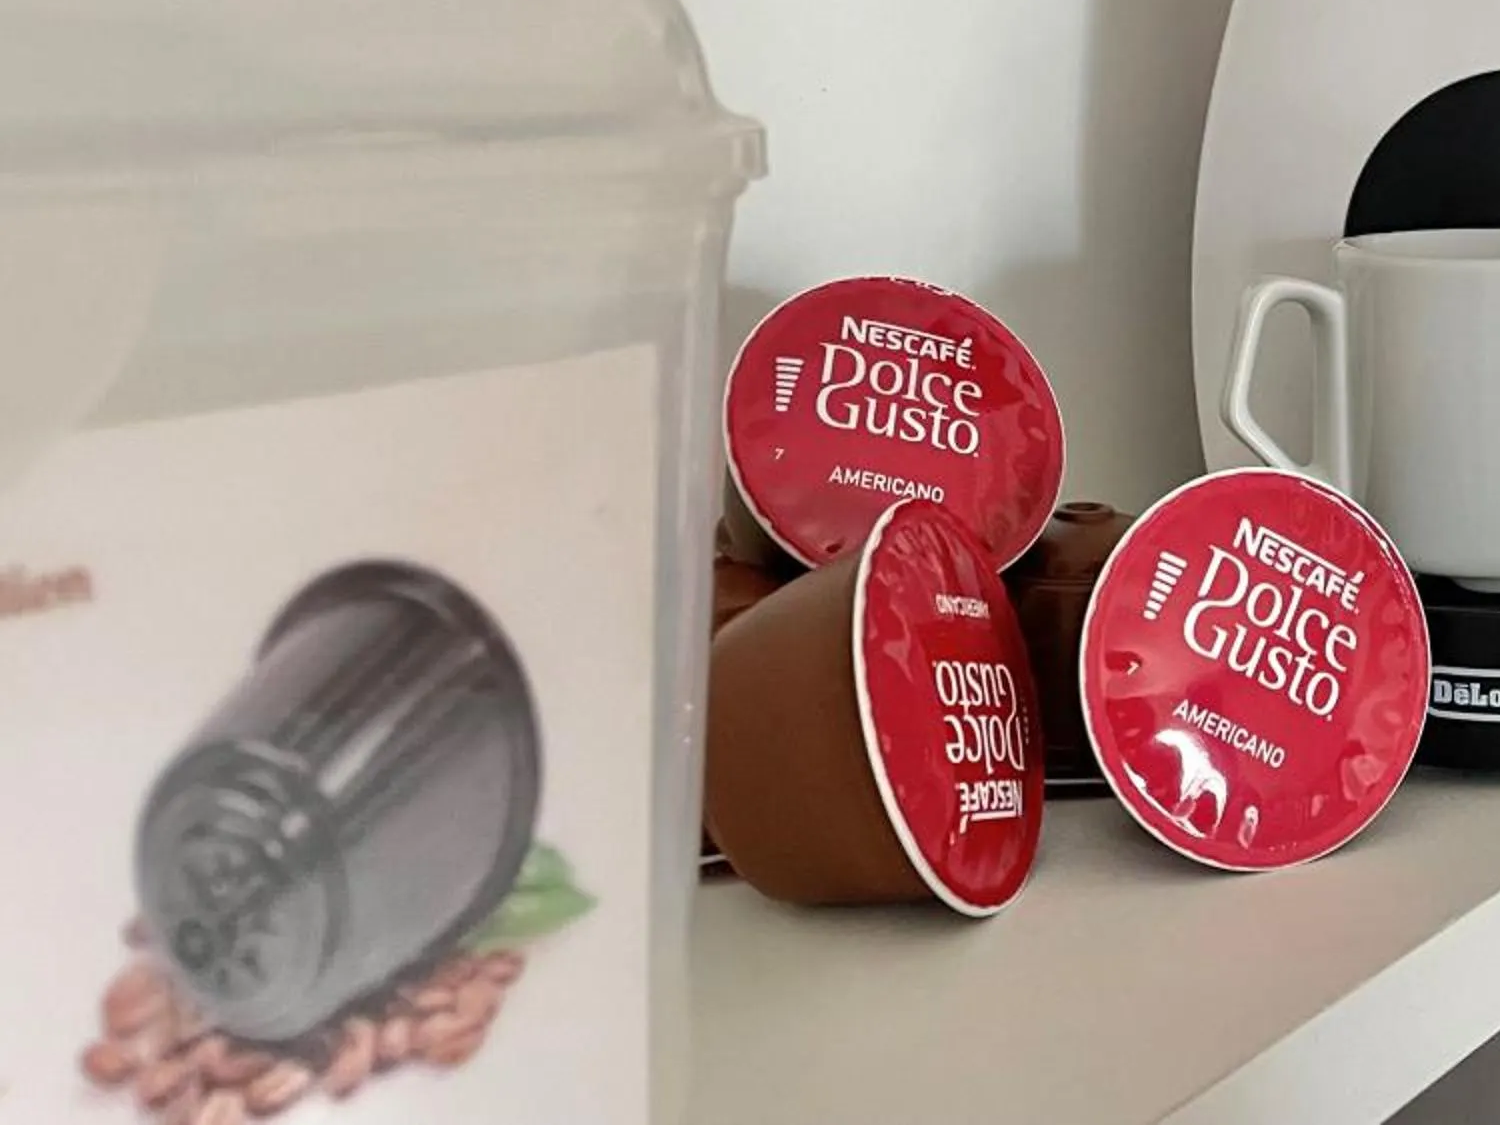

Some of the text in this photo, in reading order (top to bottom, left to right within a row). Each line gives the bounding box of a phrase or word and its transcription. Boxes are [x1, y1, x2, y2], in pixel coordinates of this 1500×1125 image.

[840, 316, 972, 369] NESCAFÉ
[820, 341, 983, 416] Dolce
[816, 381, 980, 455] Gusto
[774, 447, 786, 460] 7
[828, 465, 945, 503] AMERICANO
[1233, 517, 1364, 612] NESCAFÉ
[1198, 544, 1358, 672] Dolce
[935, 660, 1017, 714] Gusto
[1183, 599, 1341, 717] Gusto
[945, 713, 1026, 774] Dolce
[1172, 699, 1286, 768] AMERICANO
[959, 779, 1023, 834] NESCAFÉ
